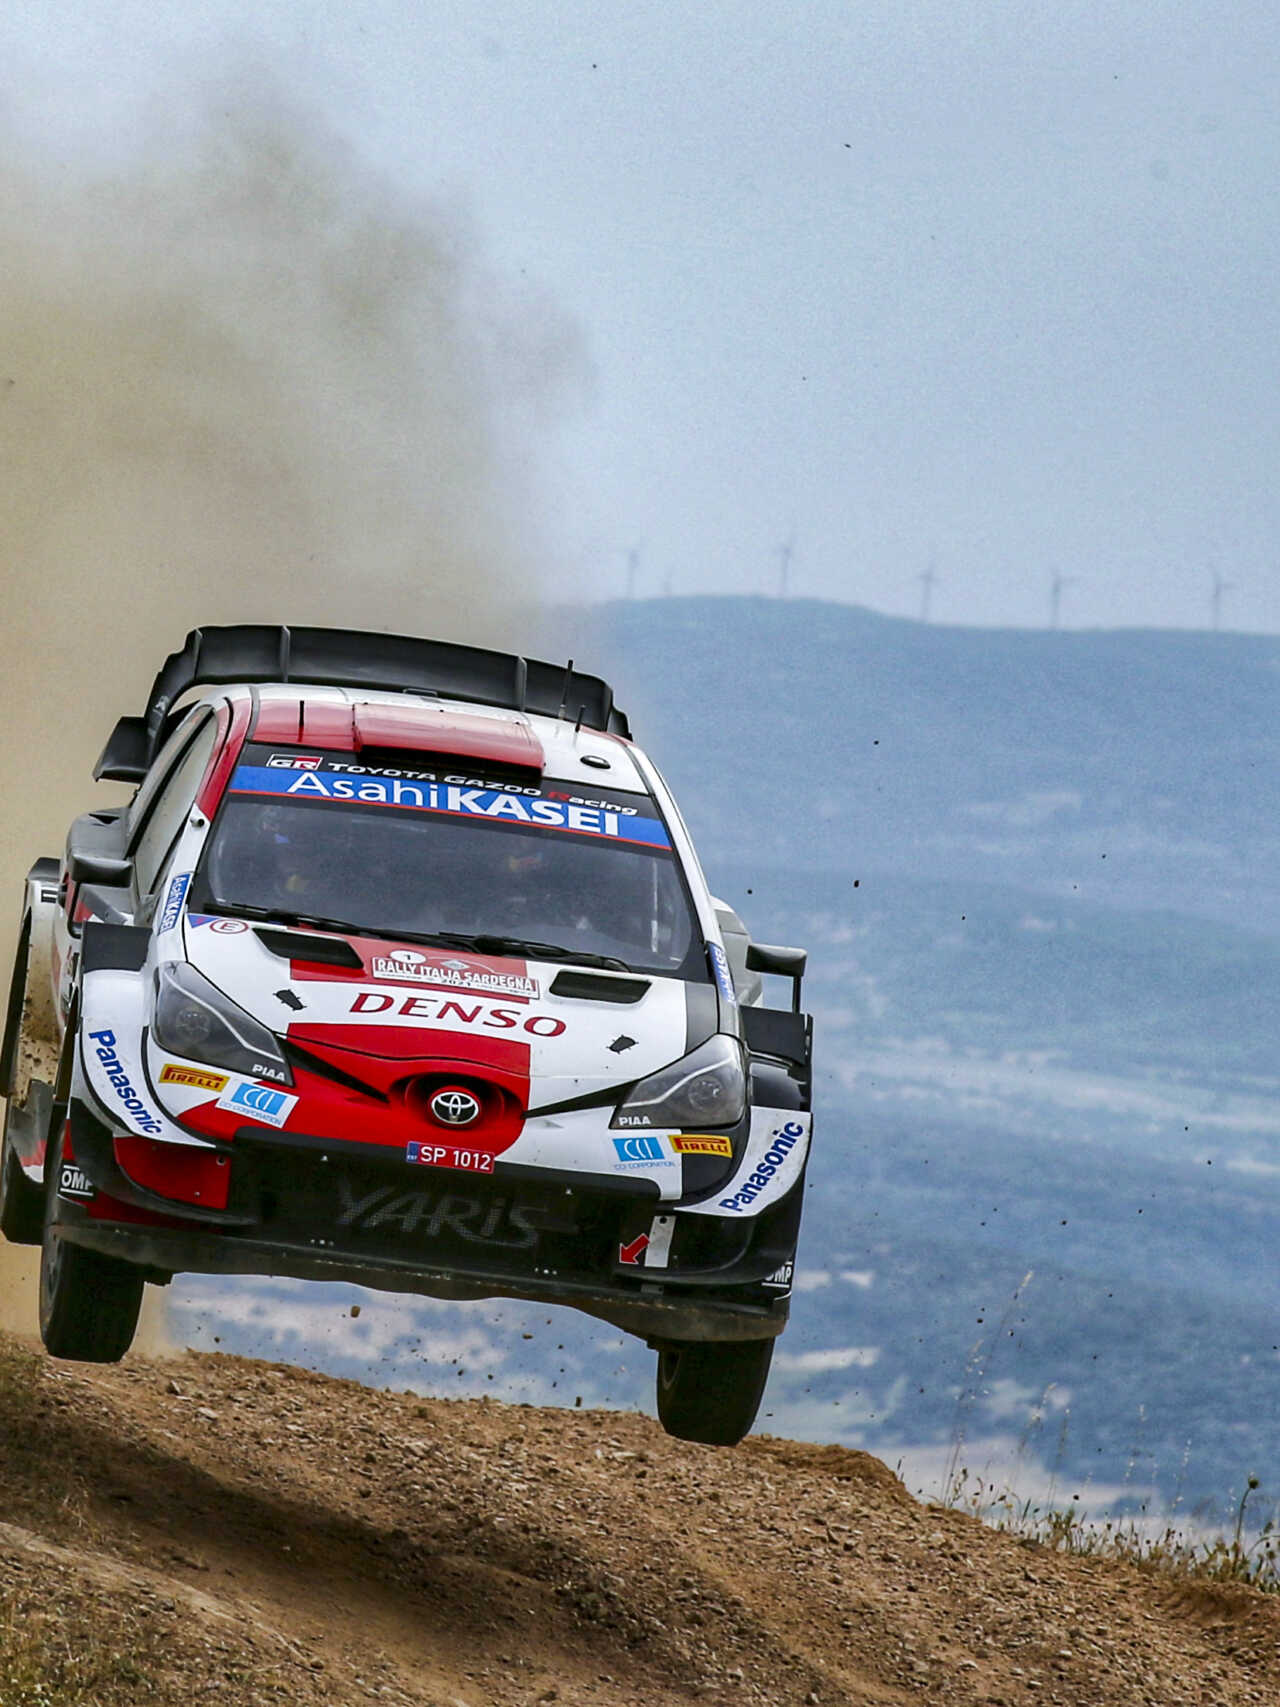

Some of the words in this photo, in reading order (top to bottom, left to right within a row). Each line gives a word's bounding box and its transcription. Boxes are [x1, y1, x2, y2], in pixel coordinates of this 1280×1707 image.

[270, 757, 318, 770] GR
[328, 762, 436, 781] TOYOTA
[443, 774, 542, 796] GAZOO
[547, 790, 638, 816] Racing
[377, 959, 417, 975] RALLY
[420, 965, 461, 981] ITALIA
[463, 971, 533, 992] SARDEGNA
[349, 992, 567, 1037] DENSO
[88, 1029, 162, 1134] Panasonic
[164, 1067, 224, 1089] PIRELLI
[252, 1064, 286, 1082] PIAA
[619, 1115, 651, 1126] PIAA
[673, 1137, 729, 1154] PIRELLI
[420, 1146, 447, 1163] SP
[453, 1150, 491, 1170] 1012
[719, 1121, 803, 1212] Panasonic
